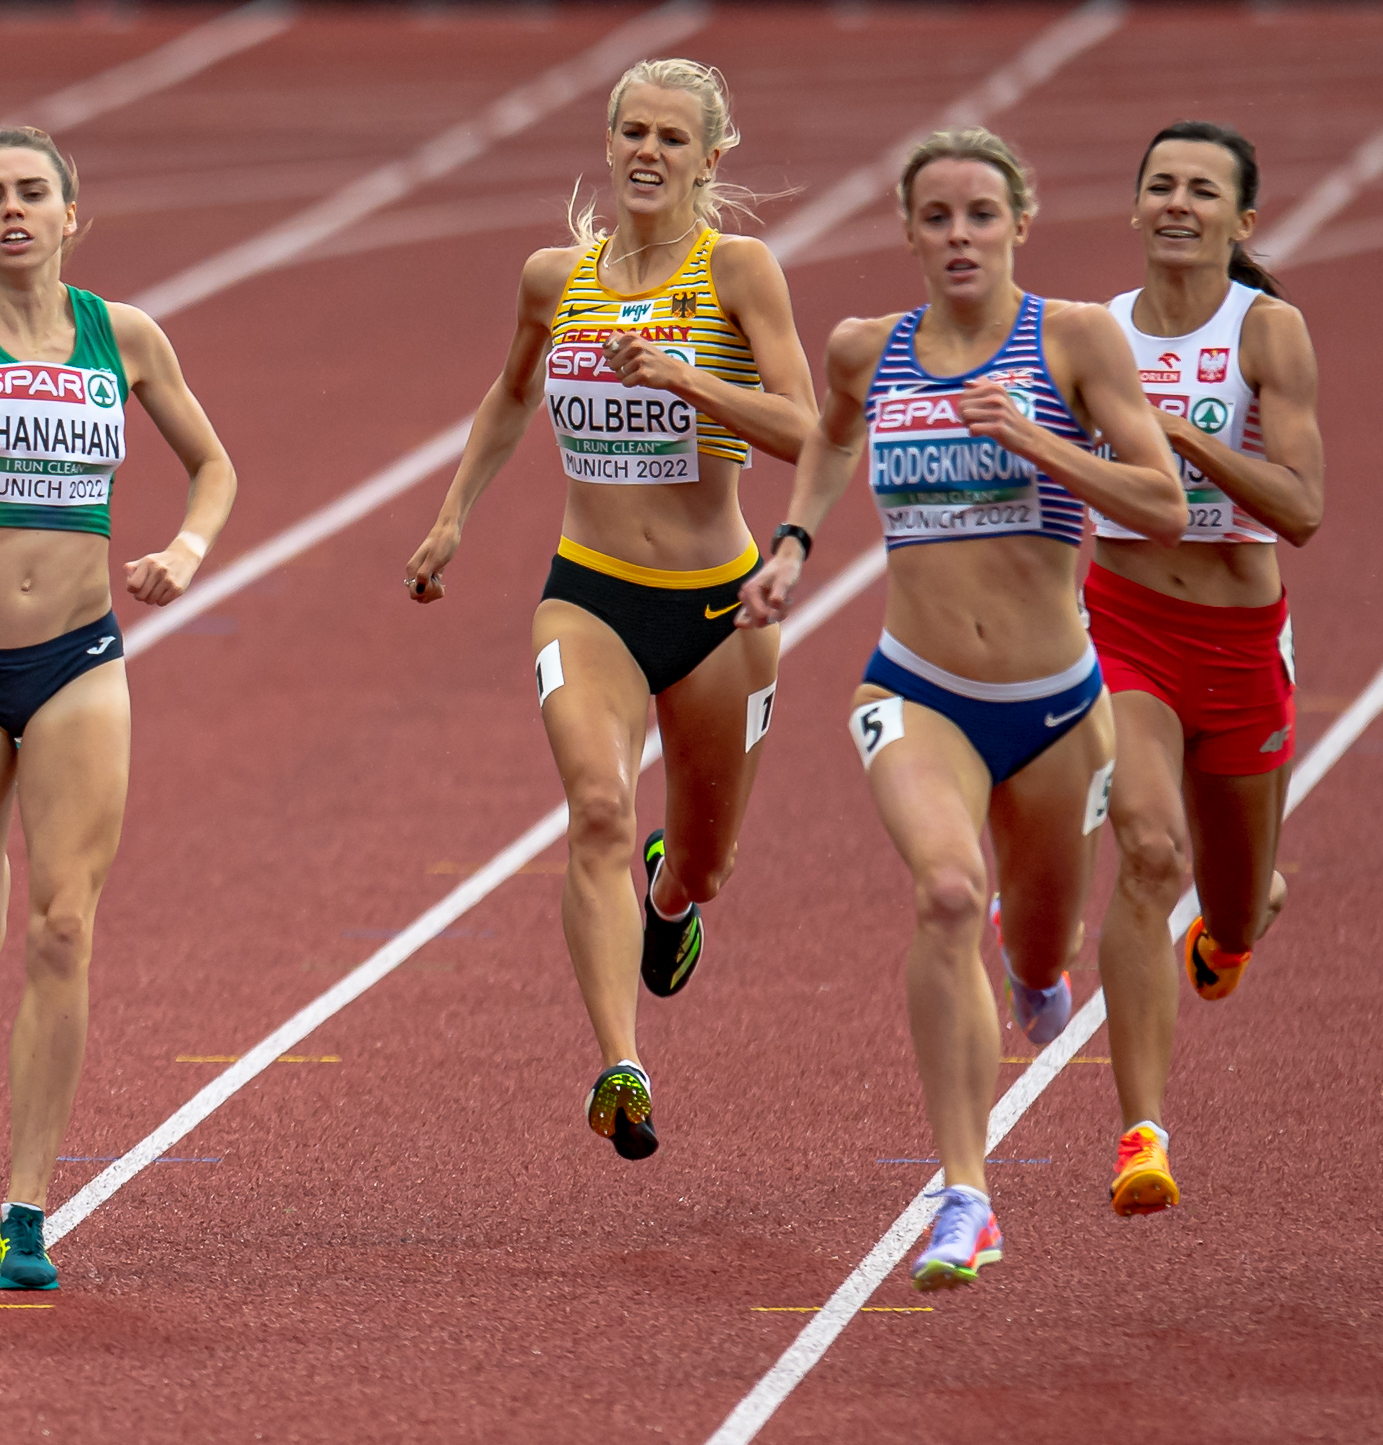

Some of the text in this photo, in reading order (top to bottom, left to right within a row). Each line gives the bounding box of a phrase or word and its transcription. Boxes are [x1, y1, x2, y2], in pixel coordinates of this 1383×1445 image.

[561, 324, 693, 344] GERANY
[1139, 372, 1178, 382] ORLEN
[549, 394, 691, 434] KOLBERG
[878, 399, 964, 429] SPA
[583, 440, 609, 453] RUN
[14, 460, 43, 472] RUN
[565, 453, 688, 479] MUNICH 2022
[872, 442, 1036, 486] HODGKINSON
[68, 479, 106, 499] 2022
[887, 504, 1031, 530] MUNICH 2022
[760, 690, 775, 733] 1
[860, 706, 884, 753] 5
